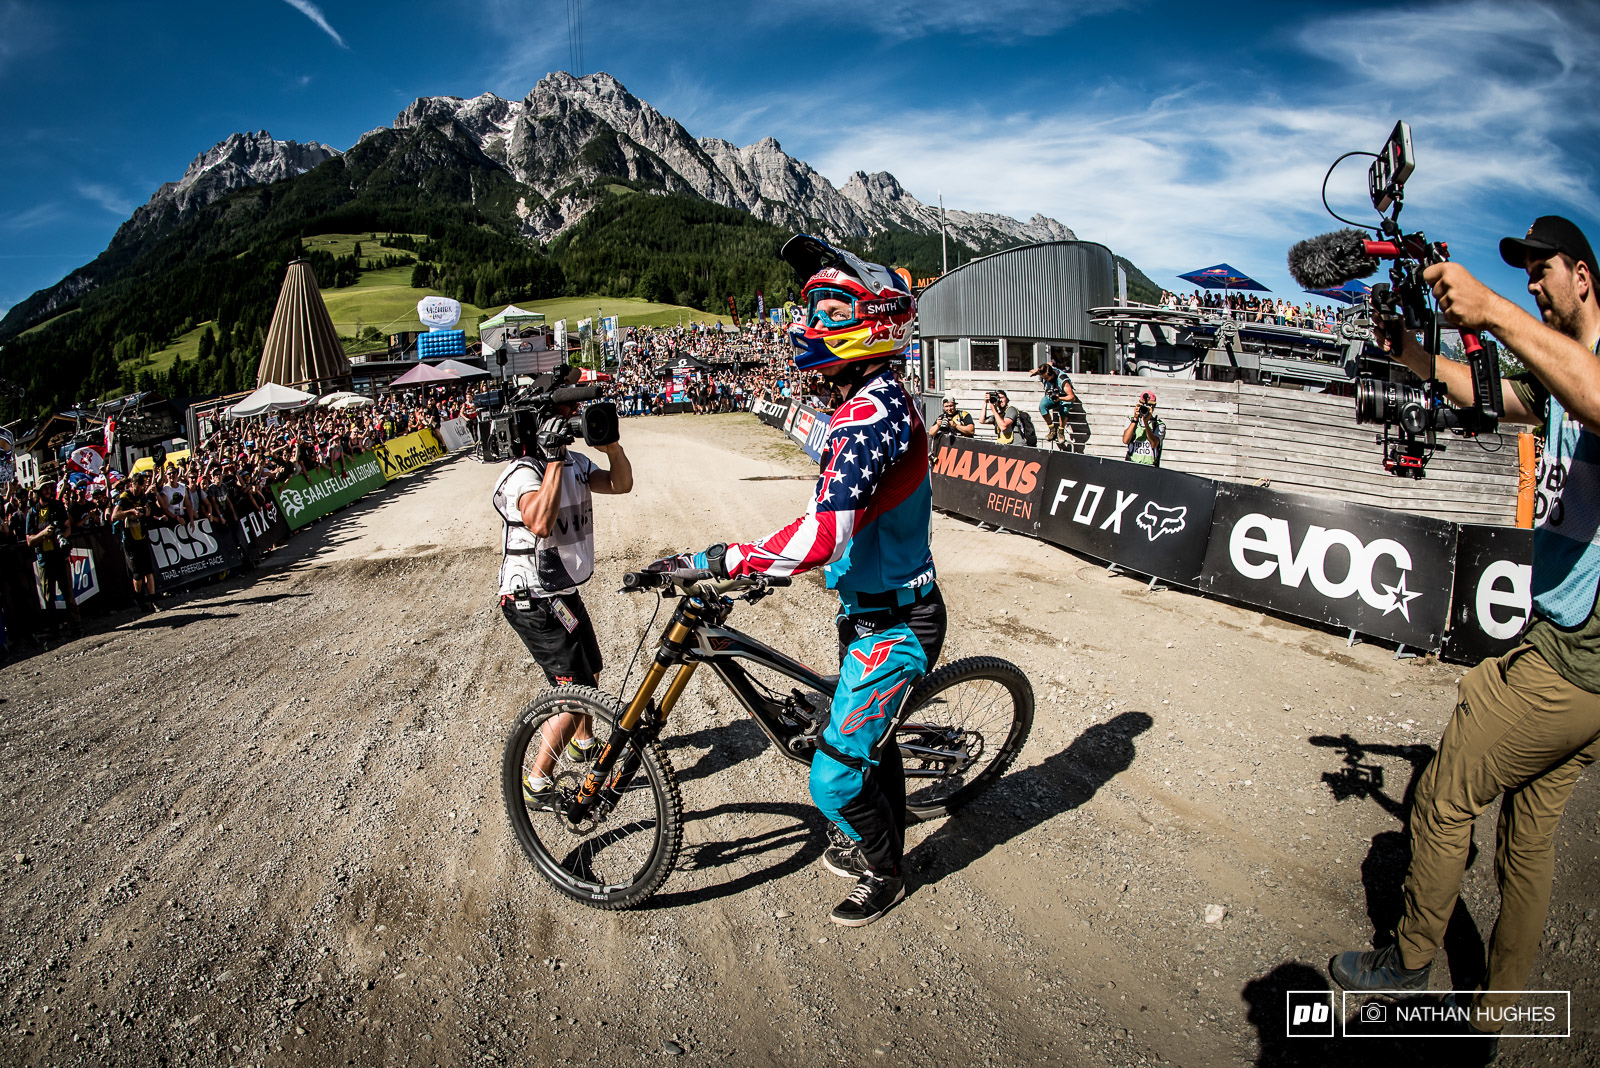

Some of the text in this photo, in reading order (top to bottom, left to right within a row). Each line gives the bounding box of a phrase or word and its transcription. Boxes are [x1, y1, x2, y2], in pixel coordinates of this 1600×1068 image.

[820, 270, 840, 280] Bull
[867, 302, 898, 315] SMITH
[354, 460, 381, 482] LEOGANG
[394, 444, 440, 472] Raiffeisen
[932, 446, 1042, 495] MAXXIS
[986, 492, 1033, 520] REIFEN
[1049, 478, 1139, 534] FOX
[240, 506, 270, 544] FOX
[161, 555, 225, 581] TRAIL FREERIDE RACE
[1475, 559, 1532, 640] e
